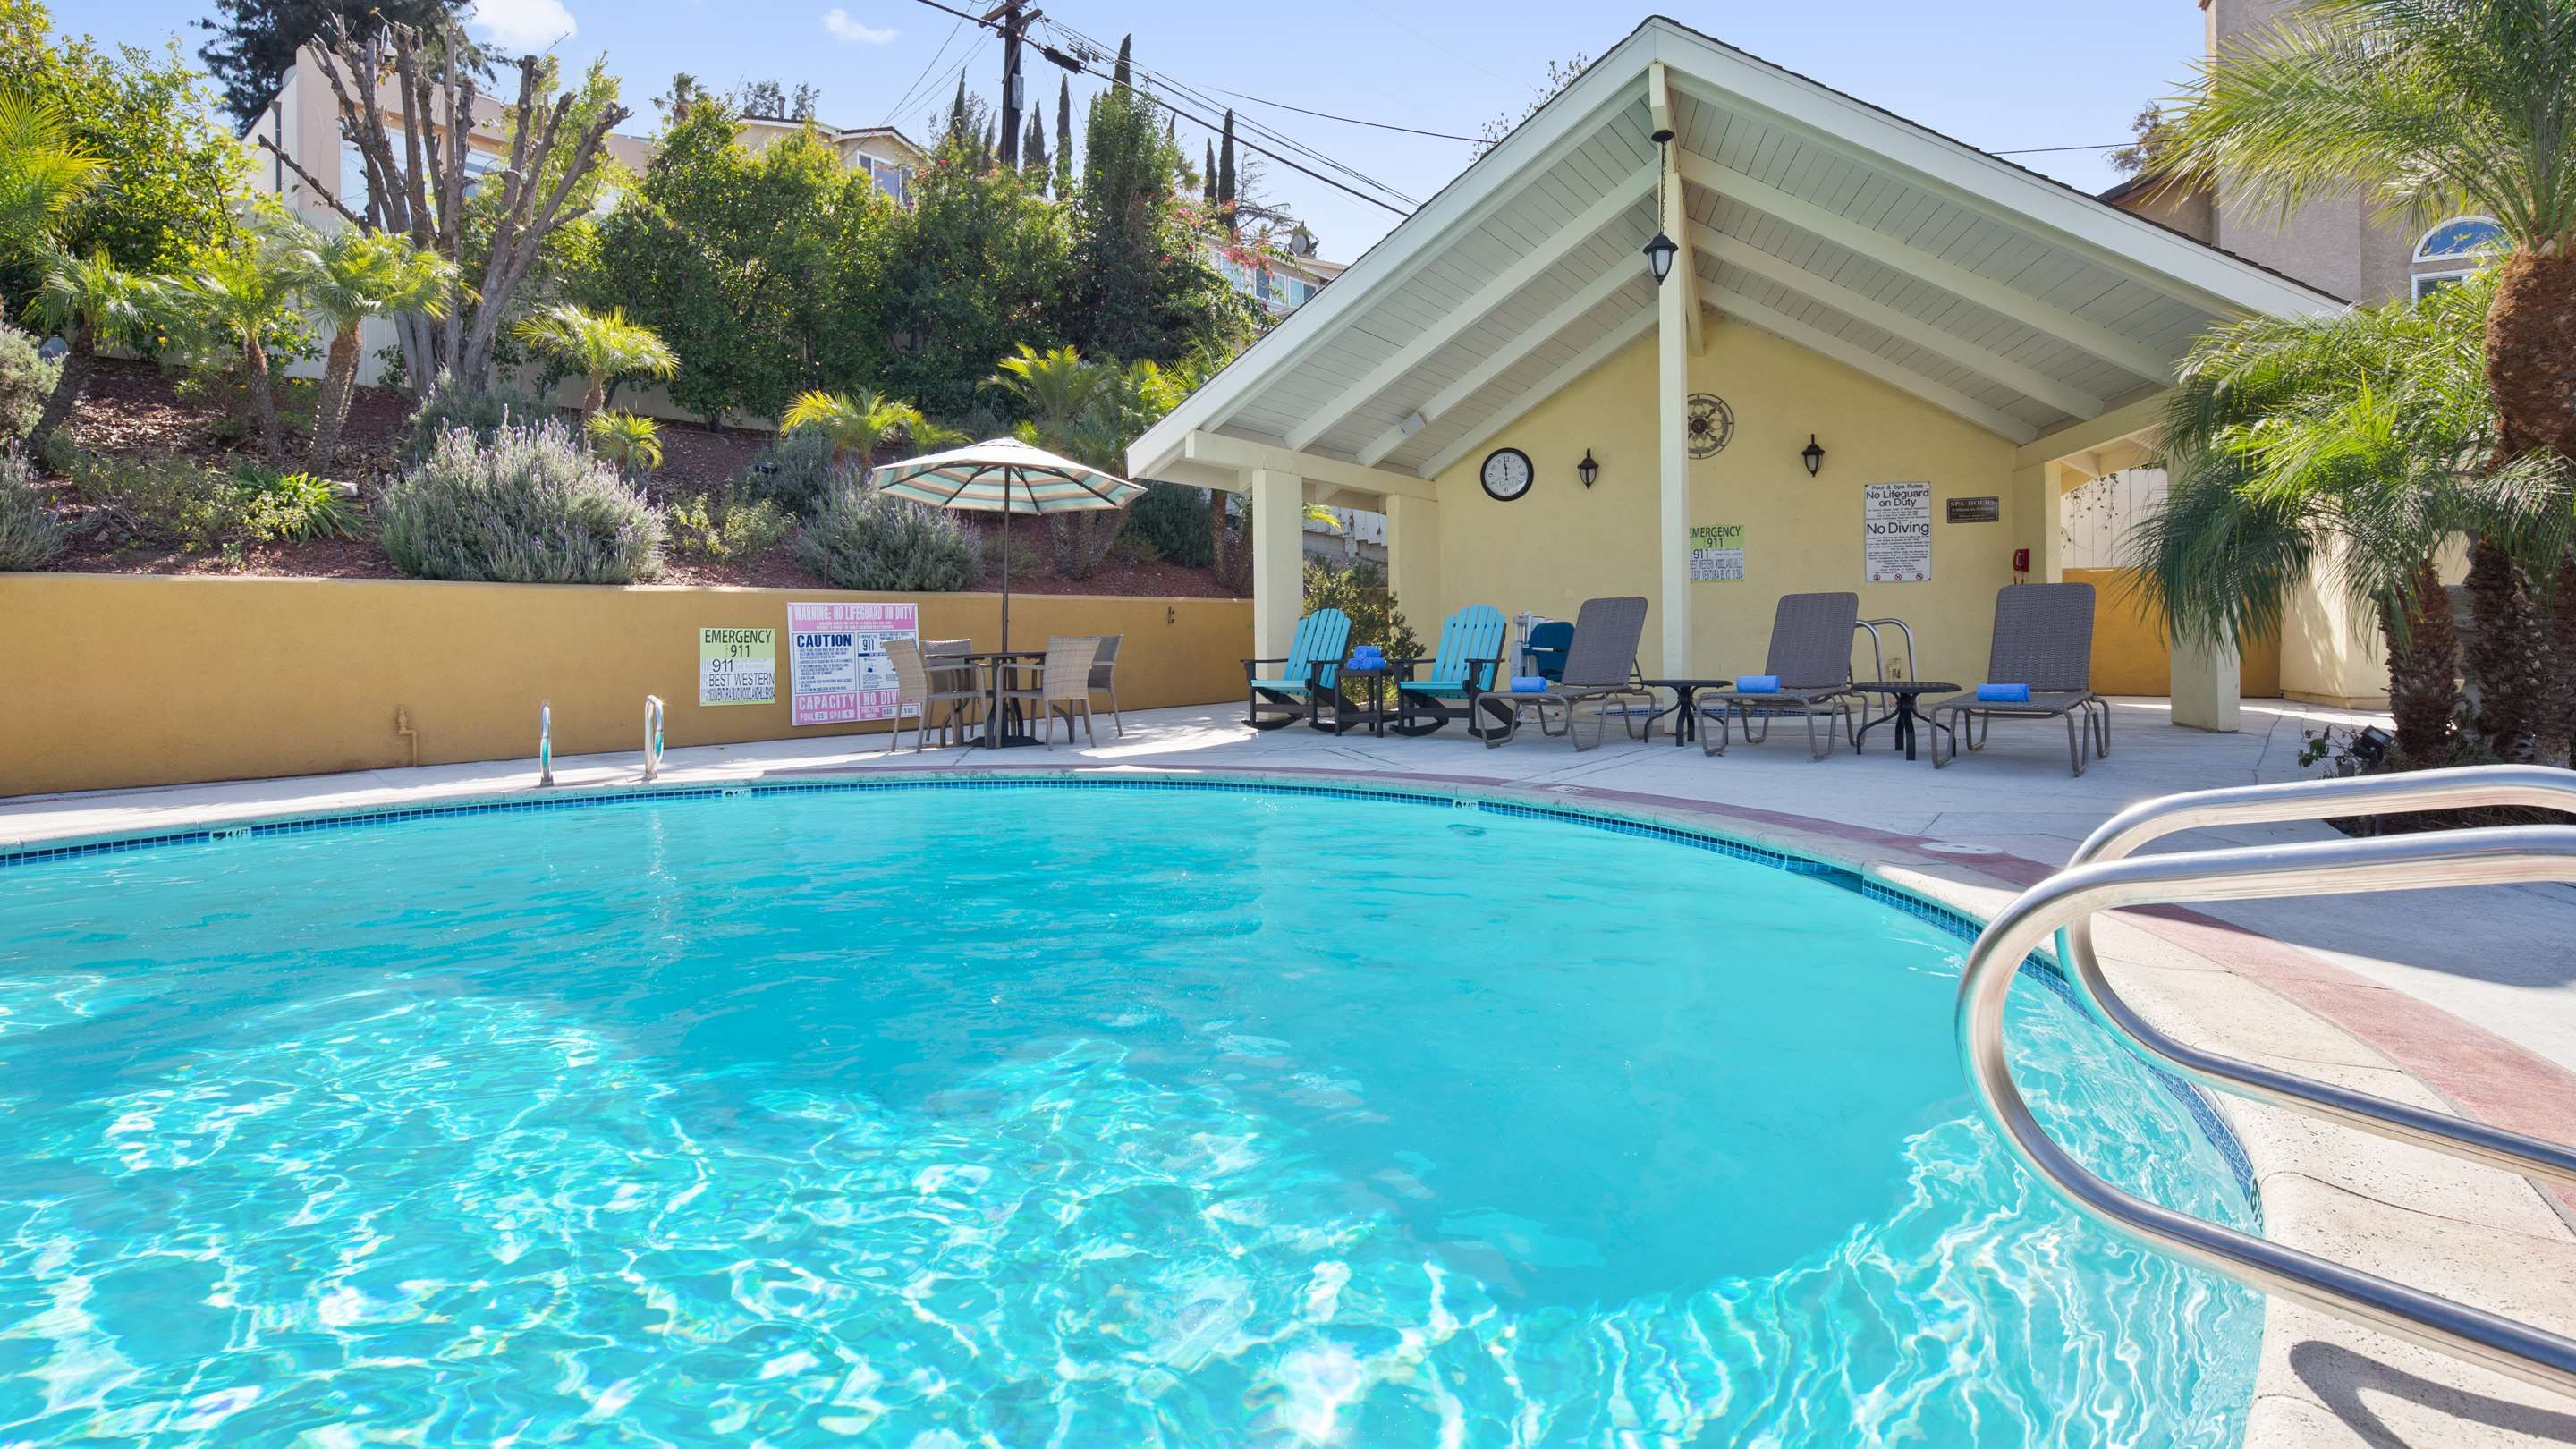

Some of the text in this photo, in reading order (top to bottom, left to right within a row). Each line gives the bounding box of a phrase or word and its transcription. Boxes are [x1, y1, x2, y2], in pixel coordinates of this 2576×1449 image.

[1867, 488, 1929, 500] No Lifeguard
[1894, 498, 1917, 508] Duty
[1867, 521, 1929, 536] No Diving
[1707, 537, 1723, 548] 911
[1693, 548, 1709, 559] 911
[794, 606, 913, 621] WARNING: NO LIFEGUARD ON DUTY
[705, 629, 772, 644] EMERGENCY
[797, 634, 852, 648] CAUTION
[730, 644, 750, 658] 911
[862, 639, 875, 651] 911
[712, 658, 733, 673] 911
[708, 672, 775, 687] BEST WESTERN
[799, 693, 855, 710] CAPACITY
[863, 692, 877, 706] NO
